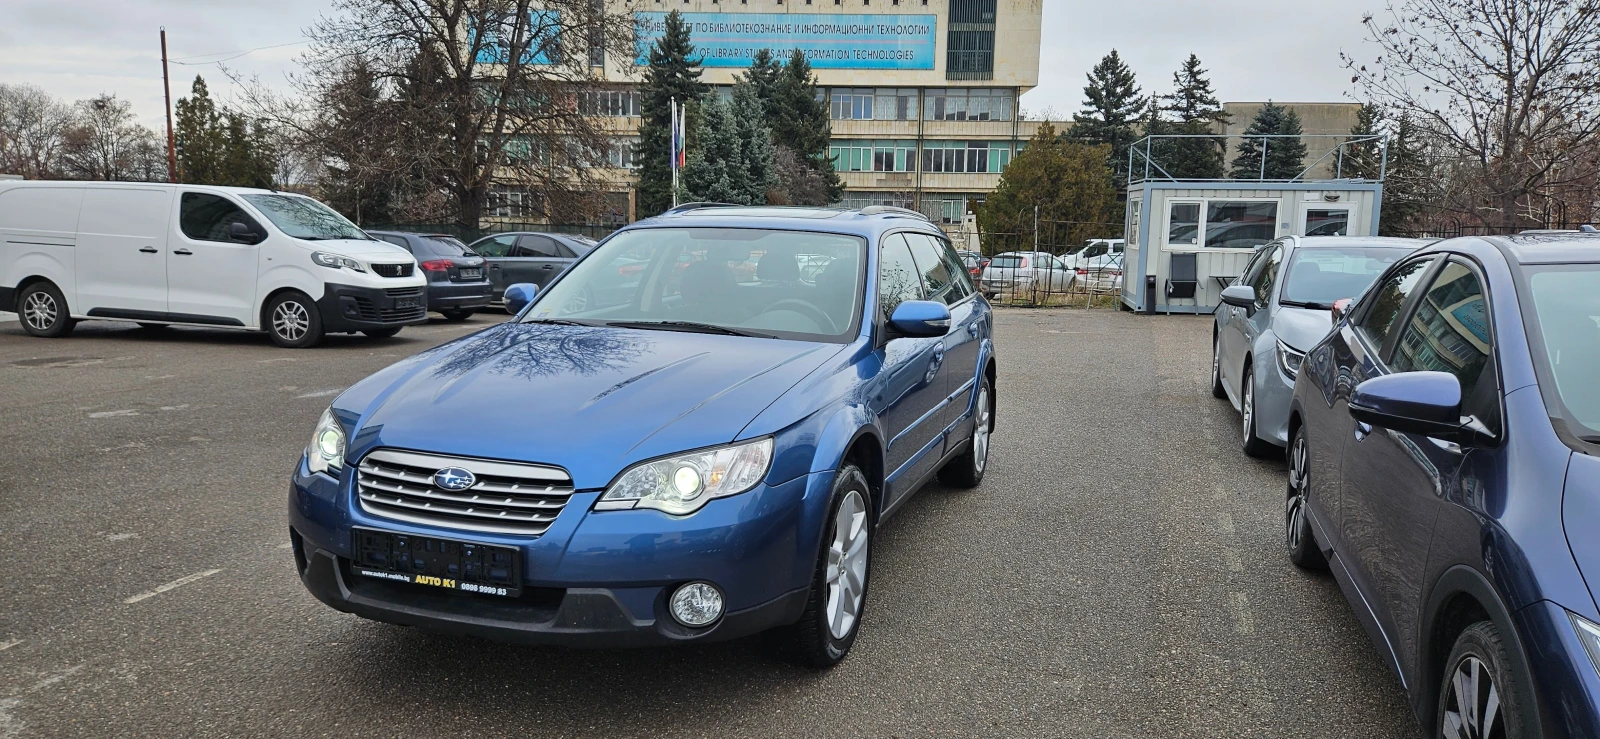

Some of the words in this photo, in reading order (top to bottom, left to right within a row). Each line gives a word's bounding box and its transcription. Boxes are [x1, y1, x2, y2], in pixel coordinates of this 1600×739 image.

[696, 22, 708, 32] ПО
[710, 22, 792, 34] БИБЛИОТЕКОЗНАНИЕ
[794, 24, 800, 34] И
[802, 24, 874, 36] ИНФОРМАЦИОННИ
[877, 24, 930, 35] ТЕХНОЛОГИИ
[700, 48, 710, 58] OF
[712, 48, 744, 58] LIBRARY
[746, 48, 774, 58] STUS
[776, 49, 792, 58] AND
[793, 50, 850, 60] FORMATION
[853, 50, 914, 60] TECHNOLOGIES
[416, 575, 441, 586] AUTO
[443, 580, 456, 588] K1
[479, 586, 496, 594] 9999
[497, 588, 507, 596] 83
